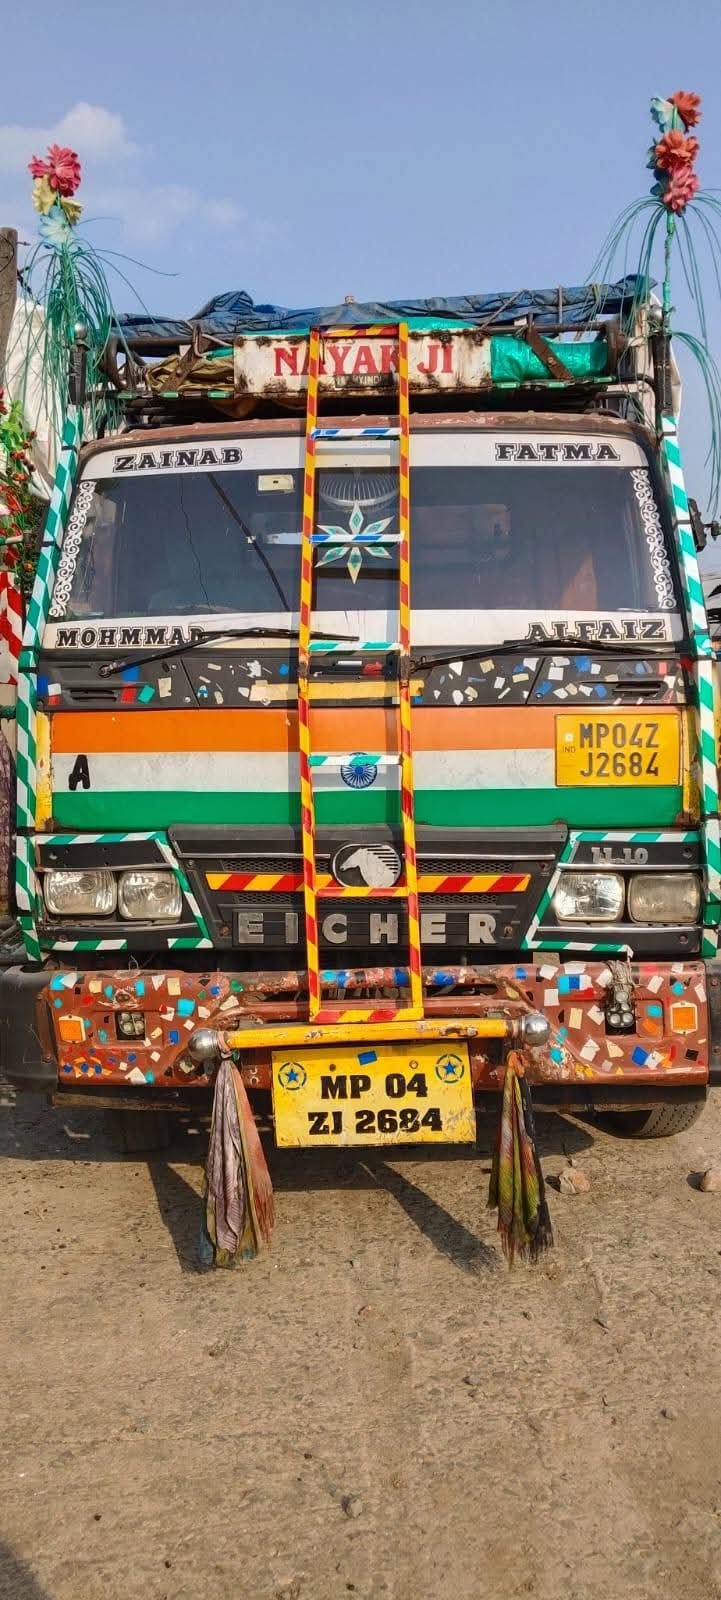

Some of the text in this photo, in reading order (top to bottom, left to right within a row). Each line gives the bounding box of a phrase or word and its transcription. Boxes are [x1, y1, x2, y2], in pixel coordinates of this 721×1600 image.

[416, 345, 455, 374] JI
[113, 447, 242, 472] ZAINAB
[495, 443, 621, 460] FATMA
[525, 619, 666, 640] ALFAIZ
[580, 723, 659, 748] MP04Z
[69, 754, 91, 791] A
[580, 752, 659, 776] J2684
[238, 913, 497, 944] EICHER
[320, 1073, 428, 1099] MP 04
[308, 1108, 443, 1135] ZJ 2684
